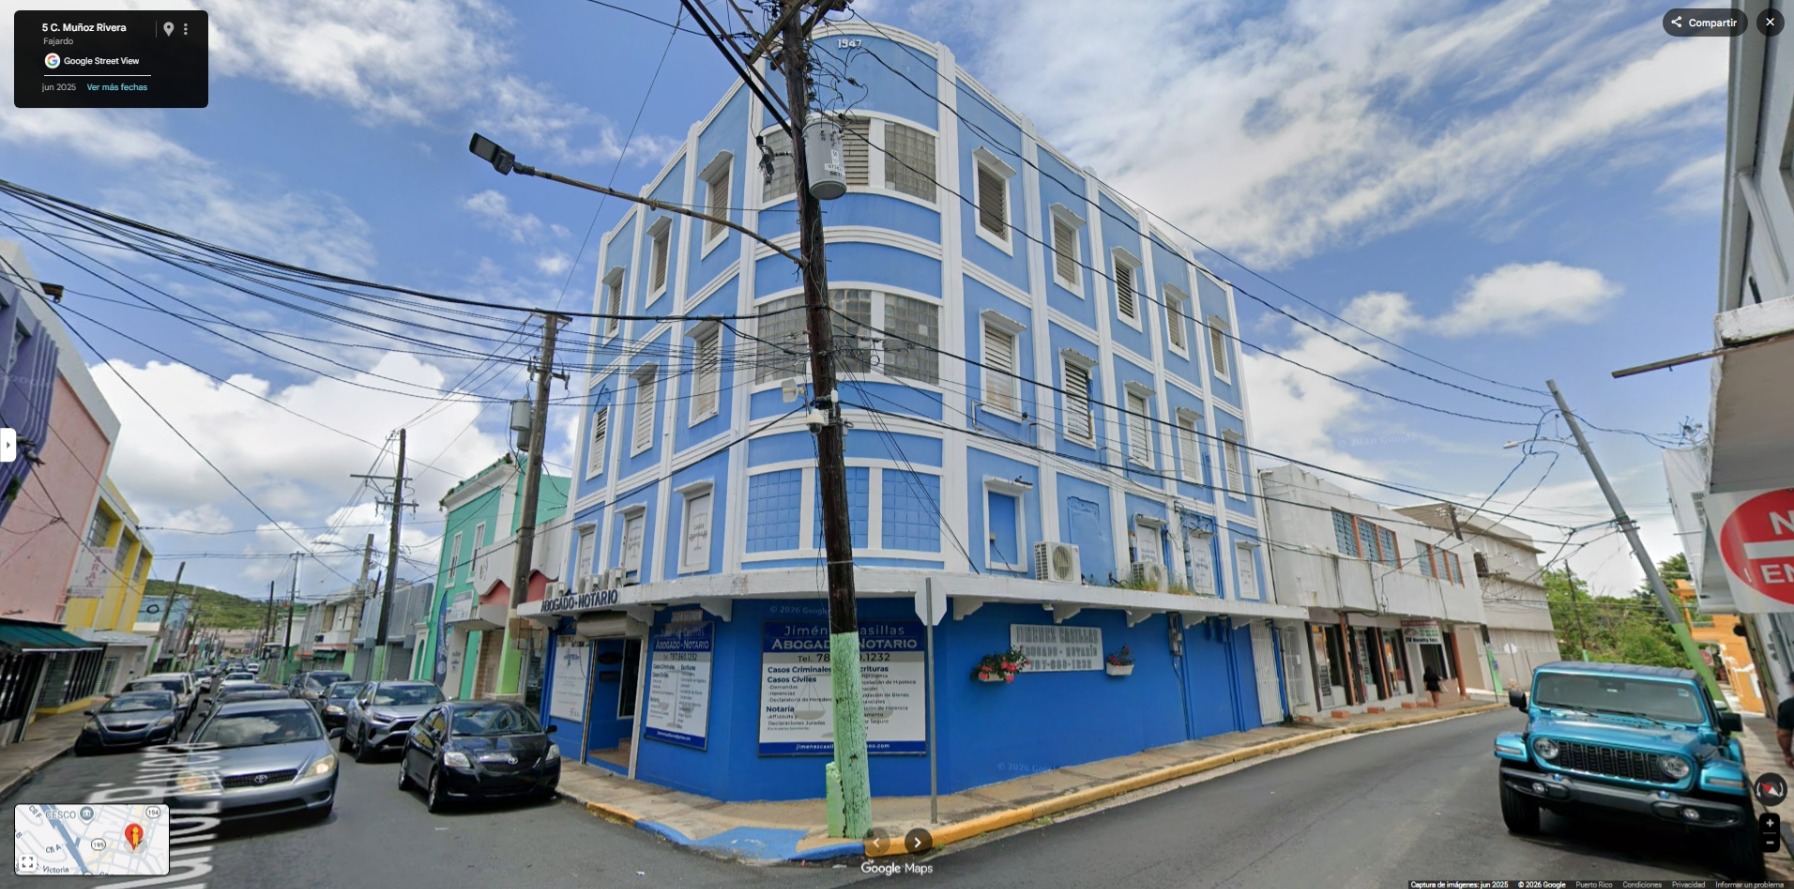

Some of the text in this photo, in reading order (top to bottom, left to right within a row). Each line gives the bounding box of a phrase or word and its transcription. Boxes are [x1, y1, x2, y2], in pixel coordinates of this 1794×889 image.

[838, 39, 862, 48] 1947
[1769, 510, 1794, 536] N
[784, 624, 905, 636] Jimén asillas
[791, 675, 817, 683] Civiles
[766, 705, 795, 713] Notaría
